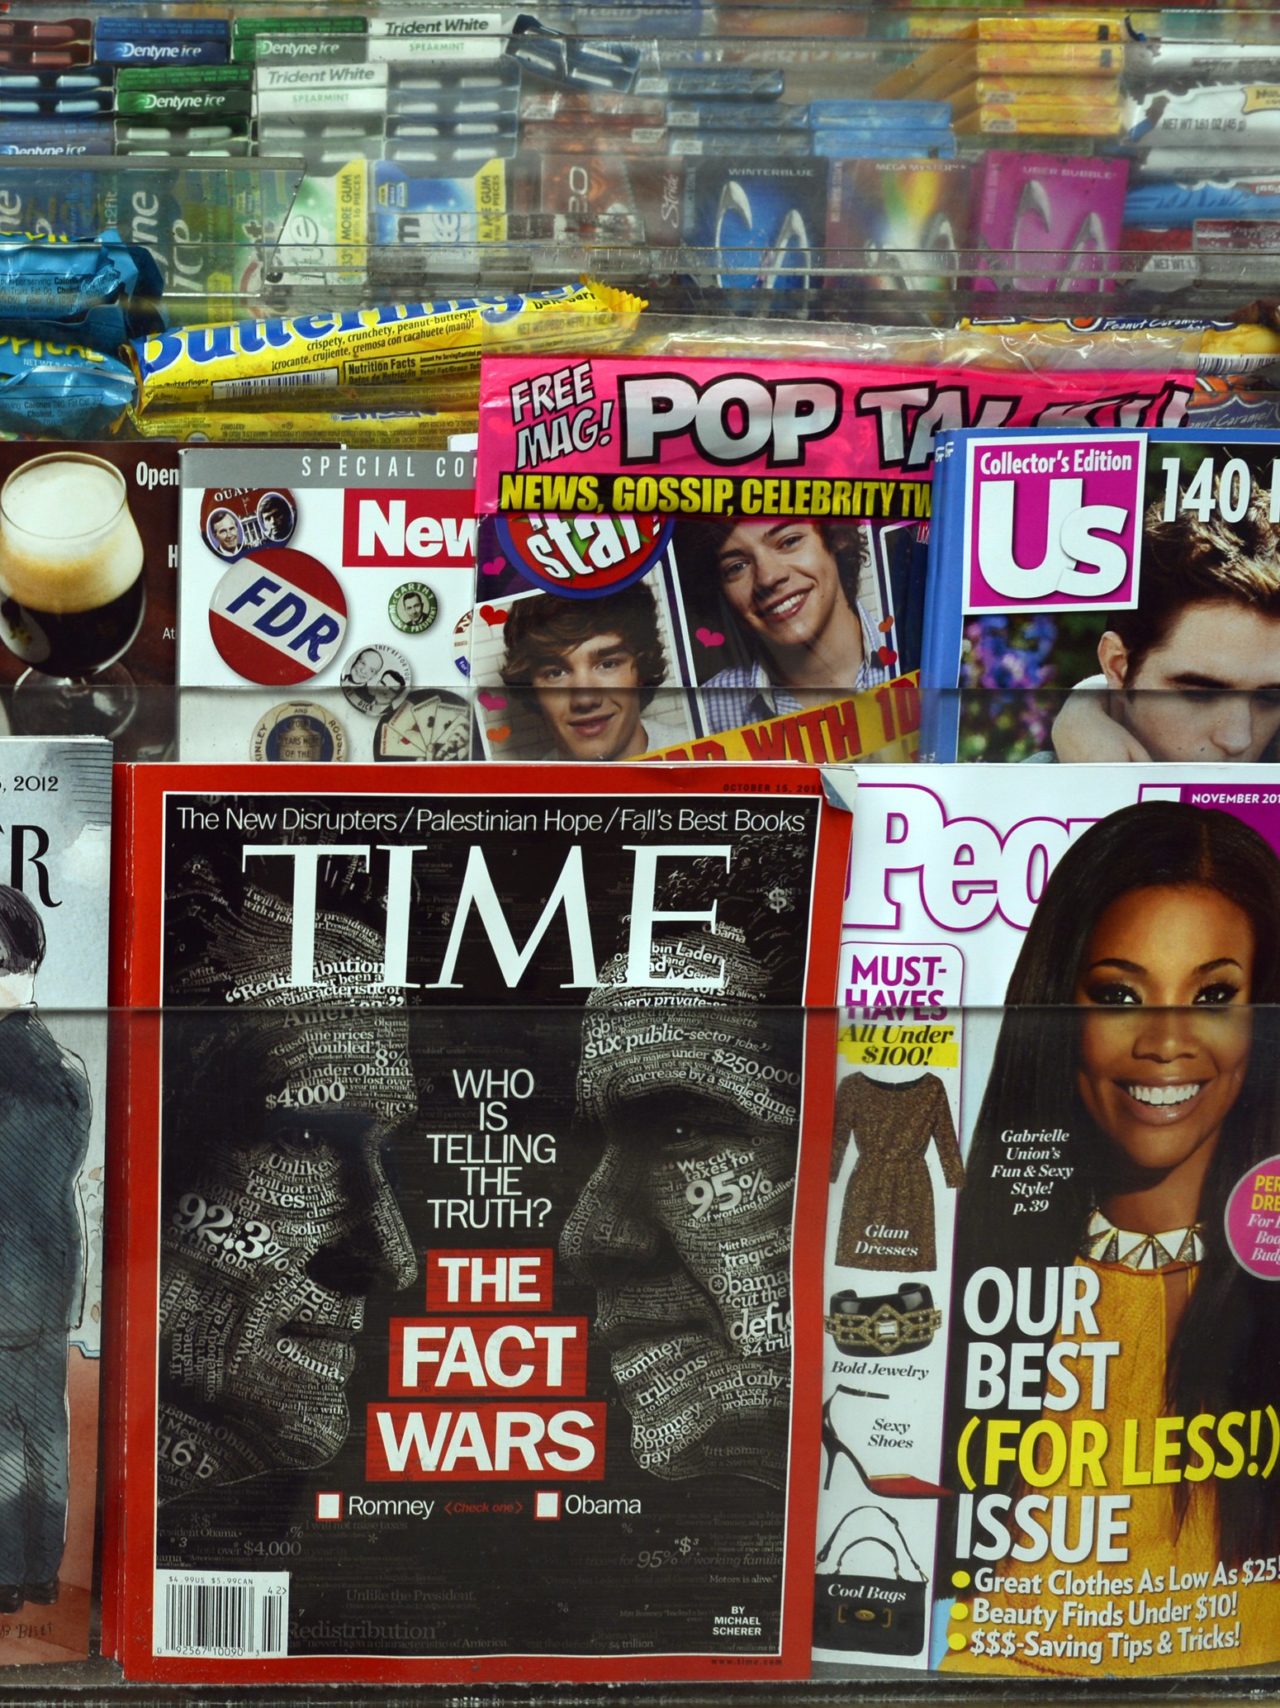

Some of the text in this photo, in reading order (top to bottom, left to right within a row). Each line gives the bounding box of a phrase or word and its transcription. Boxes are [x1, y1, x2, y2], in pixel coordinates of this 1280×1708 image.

[385, 18, 488, 35] Trident White
[122, 44, 201, 60] Dentyne ice
[409, 42, 465, 52] SPEARMINT
[268, 68, 374, 85] Trident White
[144, 94, 225, 110] Dentyne ice
[341, 175, 352, 202] GUM
[349, 358, 415, 374] Nutrition Facts
[511, 363, 594, 423] FREE
[625, 376, 837, 460] POP
[516, 401, 612, 468] MAG!
[301, 456, 415, 476] SPECIAL
[980, 448, 1131, 473] Collector's Edition
[501, 475, 896, 517] NEWS, GOSSIP, CELEBRITY
[1162, 457, 1249, 523] 140
[976, 478, 1128, 599] Us
[224, 576, 340, 662] FDR
[14, 776, 59, 792] 2012
[177, 806, 219, 830] The
[226, 808, 275, 830] New
[678, 808, 728, 831] Best
[734, 809, 805, 832] Books
[241, 844, 732, 989] TIME
[850, 954, 946, 987] MUST-
[839, 1023, 954, 1045] All Under
[862, 1046, 932, 1066] $100!
[452, 1068, 535, 1099] WHO
[480, 1101, 508, 1132] IS
[427, 1133, 556, 1166] TELLING
[460, 1166, 523, 1196] THE
[427, 1198, 552, 1229] TRUTH?
[865, 1225, 909, 1240] Glam
[854, 1241, 918, 1257] Dresses
[437, 1256, 541, 1303] THE
[963, 1267, 1100, 1336] OUR
[402, 1326, 577, 1388] FACT
[965, 1341, 1119, 1410] BEST
[872, 1418, 911, 1434] Sexy
[375, 1411, 596, 1472] WARS
[867, 1434, 914, 1450] Shoes
[957, 1405, 1280, 1490] (FOR LESS!)
[349, 1496, 435, 1520] Romney
[565, 1495, 641, 1515] Obama
[955, 1493, 1130, 1562] ISSUE
[974, 1572, 1041, 1596] Great
[1048, 1569, 1133, 1596] Clothes
[1138, 1570, 1164, 1594] As
[1169, 1568, 1209, 1590] Low
[1213, 1565, 1237, 1586] As
[714, 1616, 762, 1625] MICHAEL
[731, 1606, 745, 1615] BY
[973, 1592, 1238, 1631] Beauty Finds Under $10!
[712, 1627, 762, 1635] SCHERER
